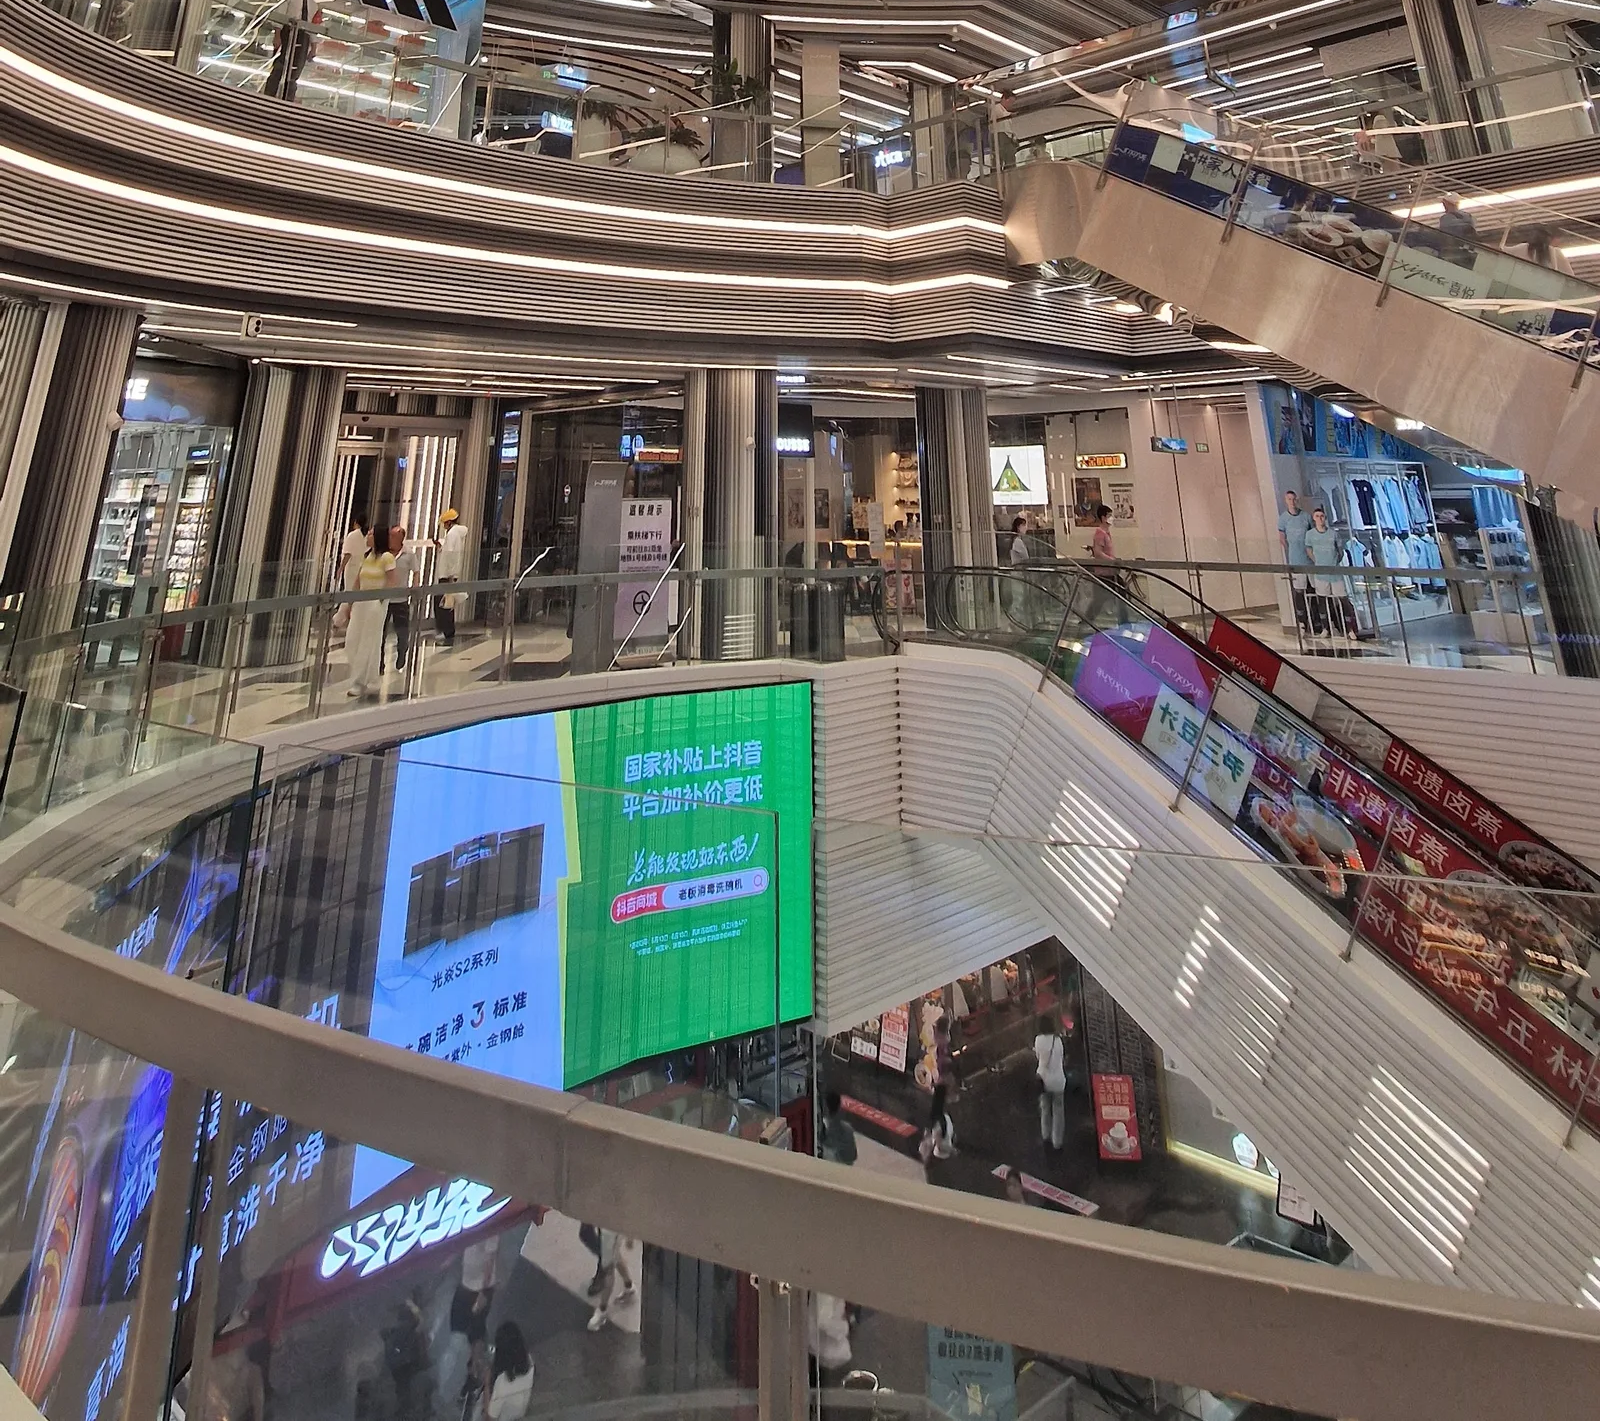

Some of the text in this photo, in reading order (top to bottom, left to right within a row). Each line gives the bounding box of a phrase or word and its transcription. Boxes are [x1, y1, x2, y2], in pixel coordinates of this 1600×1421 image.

[1448, 280, 1476, 300] 喜悦
[628, 504, 663, 517] 温馨提示
[624, 739, 763, 783] 国家补贴上抖音
[622, 774, 764, 822] 平台加补价更低
[678, 878, 743, 901] 老板消毒洗碗机
[616, 891, 658, 917] 抖音商城
[431, 946, 499, 992] 光焱S2系列
